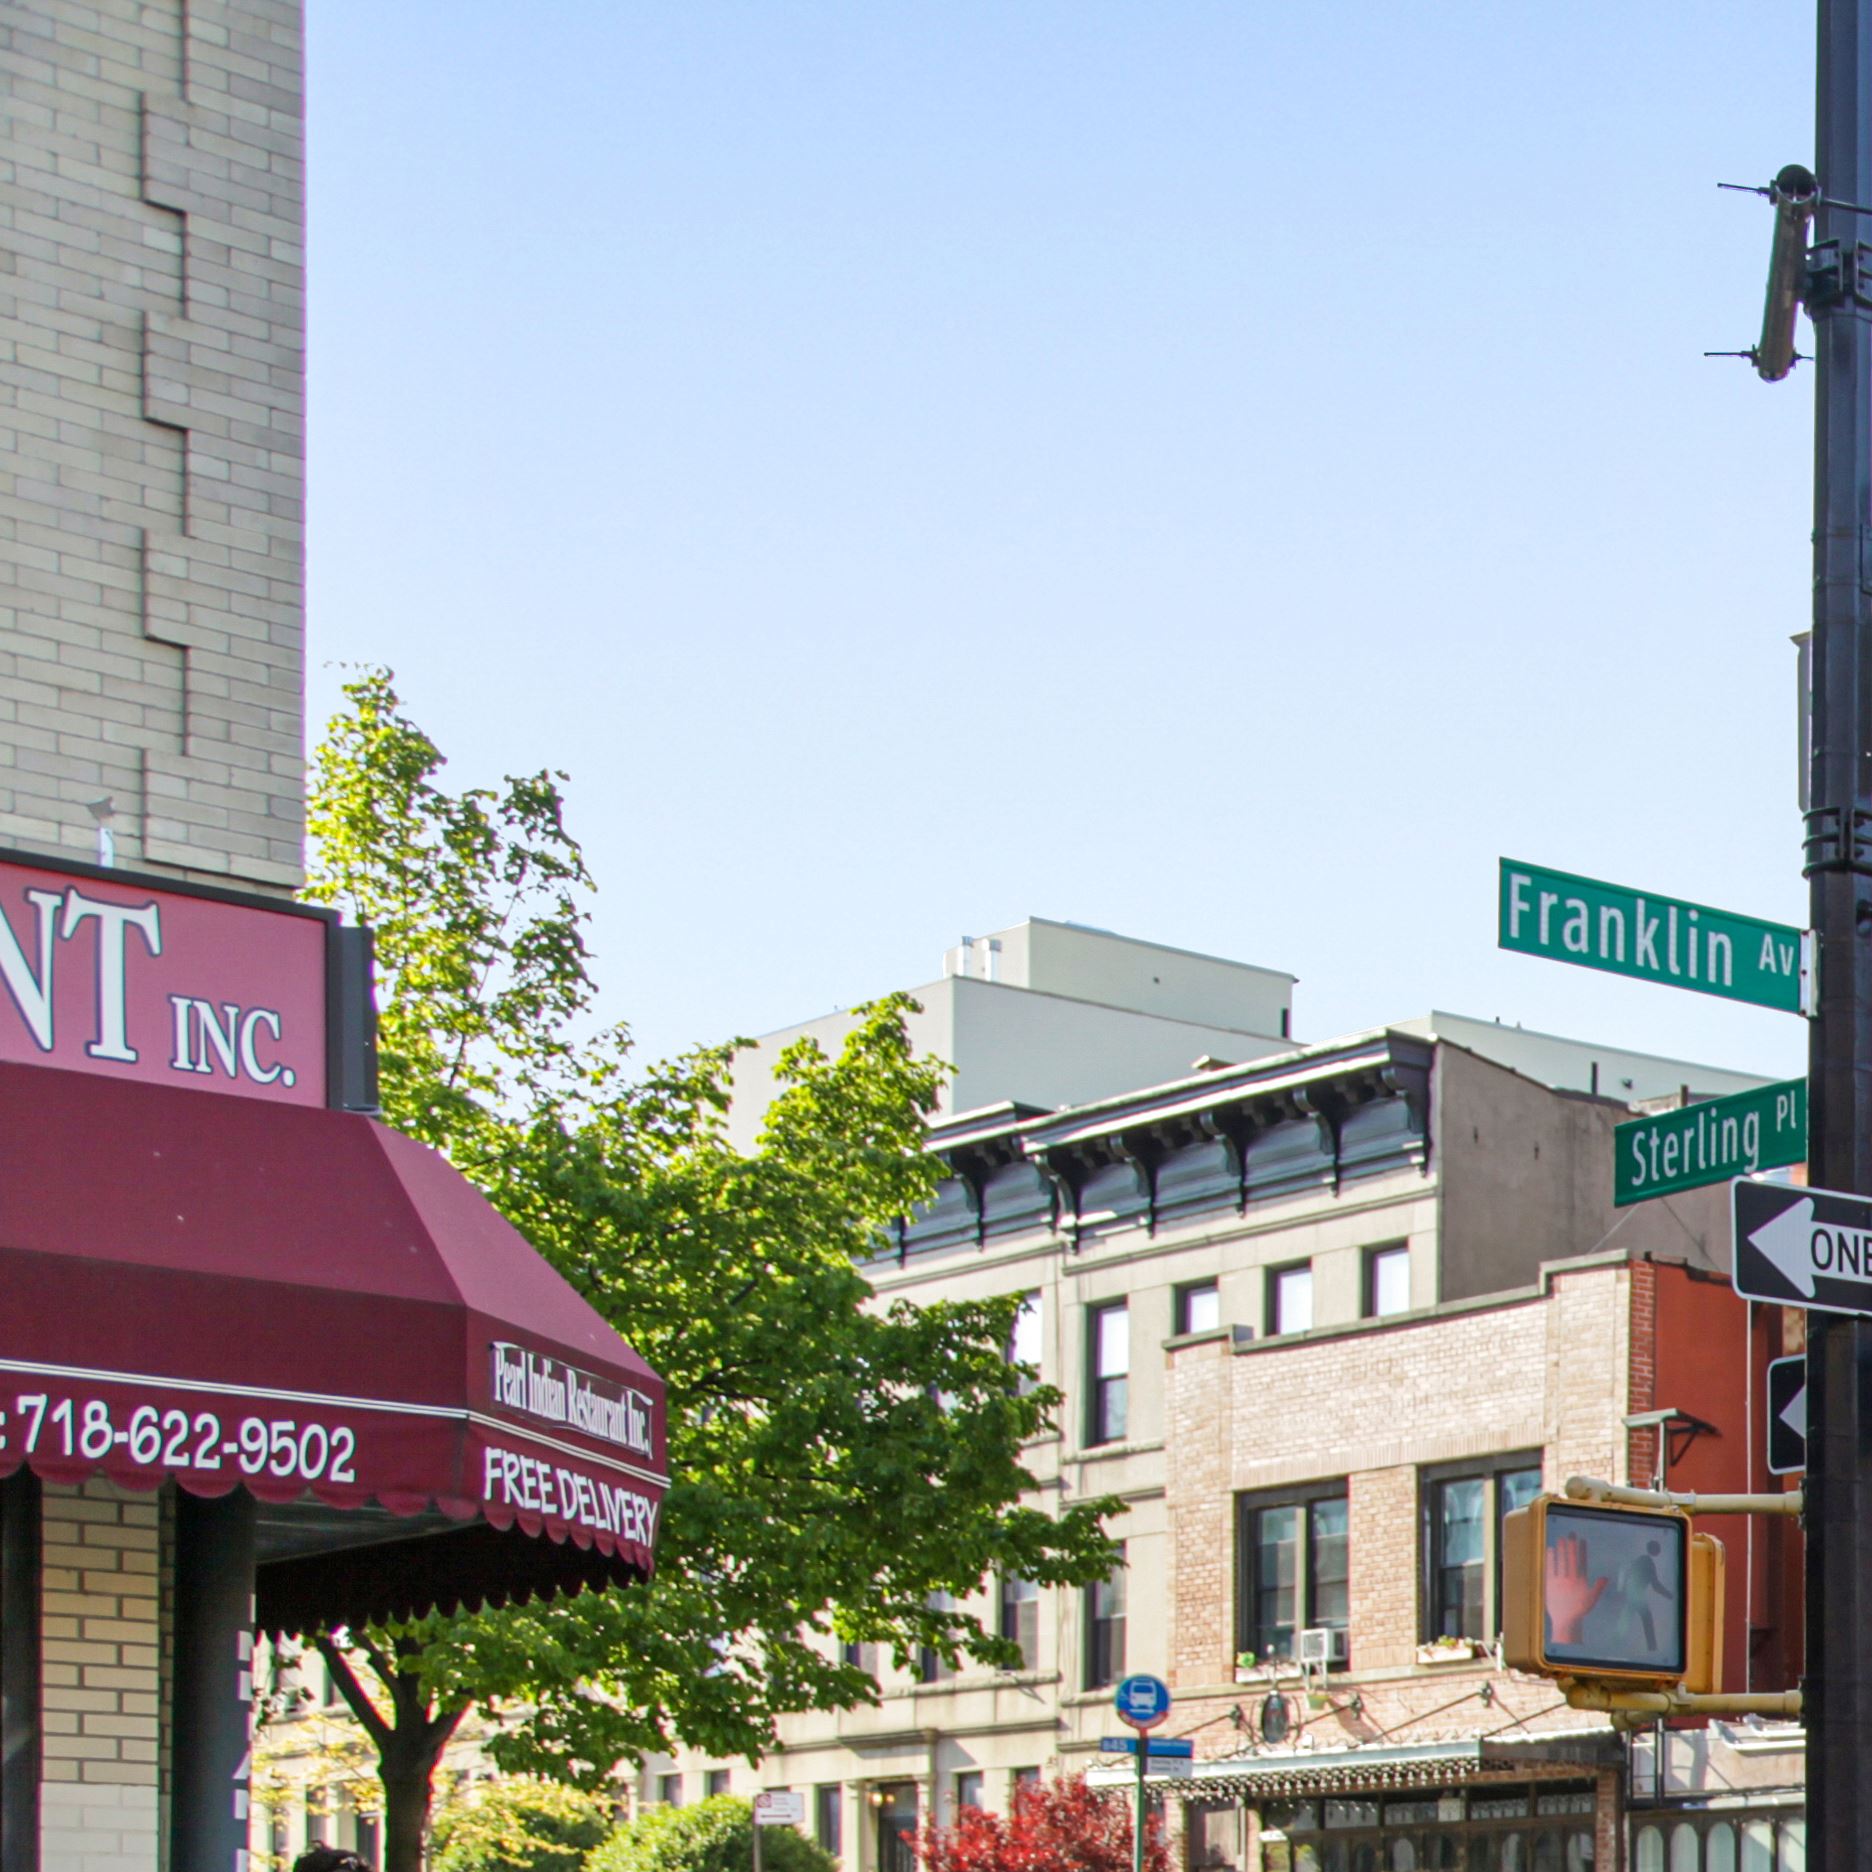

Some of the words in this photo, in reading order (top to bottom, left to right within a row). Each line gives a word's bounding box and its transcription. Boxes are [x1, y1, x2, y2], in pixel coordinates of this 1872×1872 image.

[1510, 873, 1733, 987] Franklin
[1758, 932, 1795, 977] Av
[169, 994, 297, 1088] INC.
[1631, 1106, 1760, 1187] Sterling
[1776, 1089, 1797, 1133] Pl
[17, 1393, 356, 1483] 718-622-9502
[493, 1346, 528, 1411] Pearl
[527, 1352, 568, 1422] Indian
[566, 1368, 628, 1443] Restaurant
[626, 1389, 650, 1453] Inc.
[484, 1446, 559, 1514] FREE
[555, 1467, 659, 1548] DELIVERY
